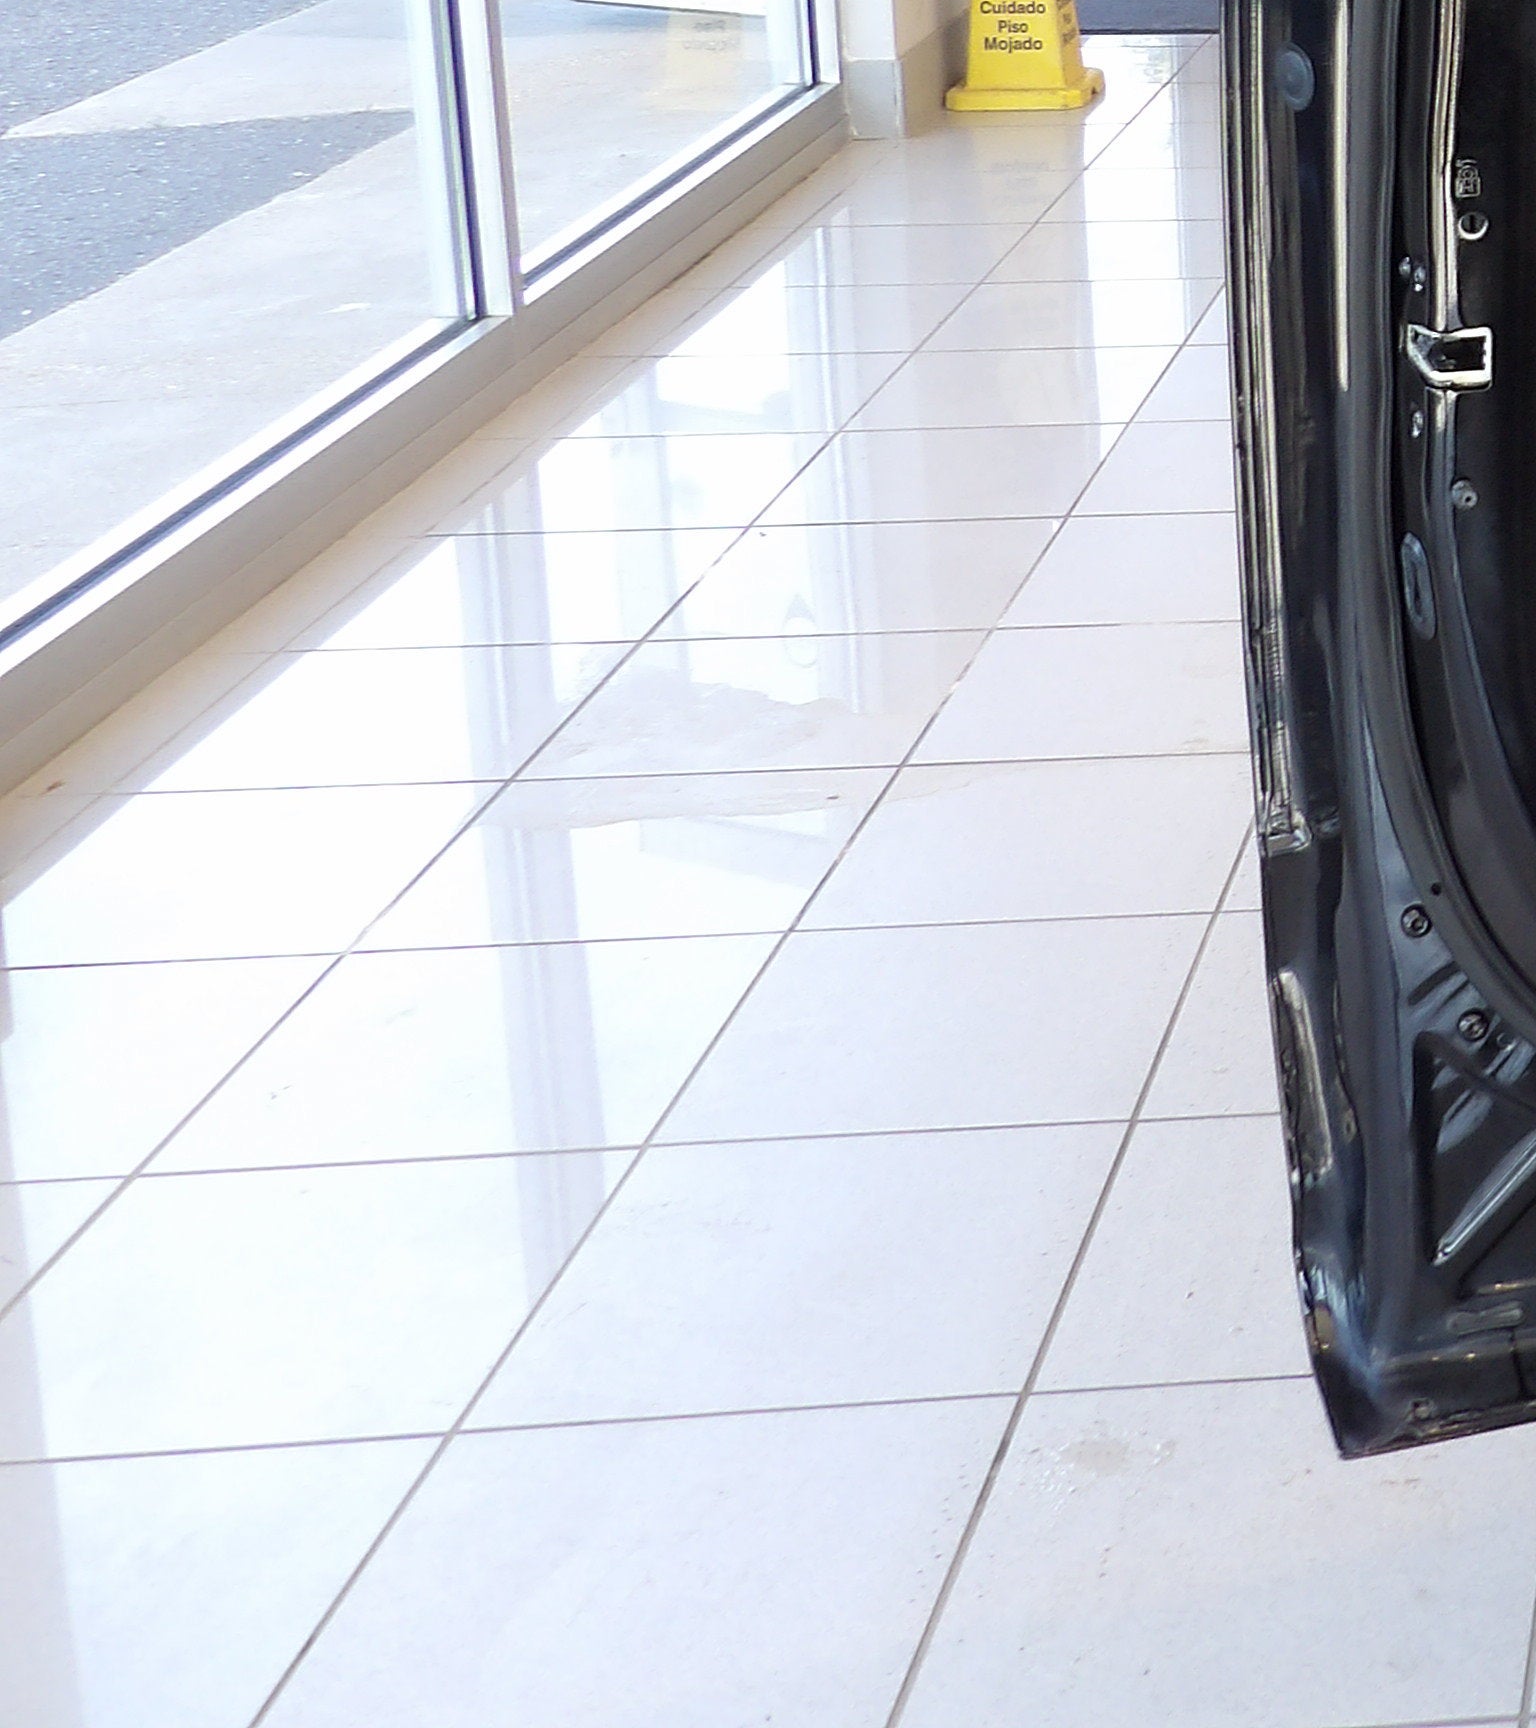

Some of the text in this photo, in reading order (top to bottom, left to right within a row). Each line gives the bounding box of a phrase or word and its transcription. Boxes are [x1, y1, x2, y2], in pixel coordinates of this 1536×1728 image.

[980, 0, 1046, 14] Cuidado
[998, 20, 1029, 33] Piso
[984, 36, 1043, 54] Mojado
